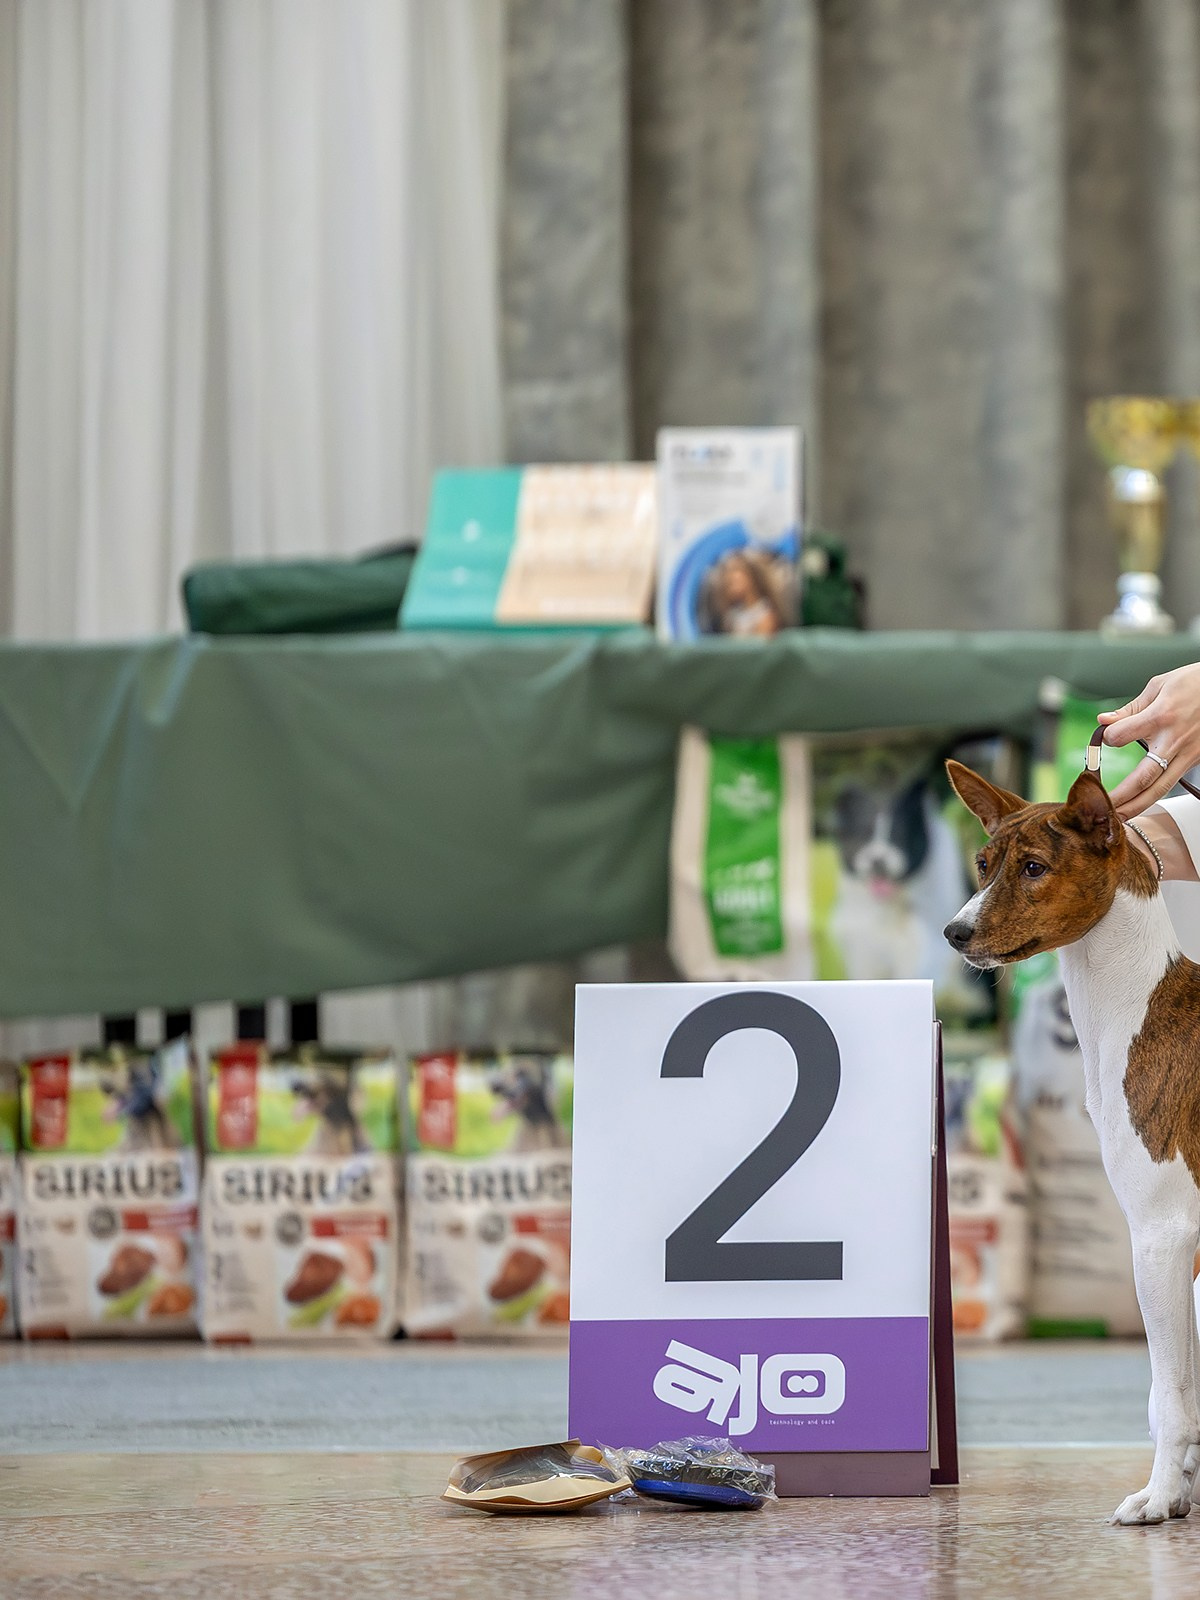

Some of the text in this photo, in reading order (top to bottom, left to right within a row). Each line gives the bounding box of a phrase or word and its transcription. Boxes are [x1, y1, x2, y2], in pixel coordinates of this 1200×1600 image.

[660, 991, 843, 1280] 2
[33, 1165, 184, 1199] SIRIUS
[223, 1165, 373, 1204] SIRIUS
[423, 1164, 572, 1201] SIRIUS
[769, 1418, 804, 1426] technology
[807, 1418, 818, 1426] and
